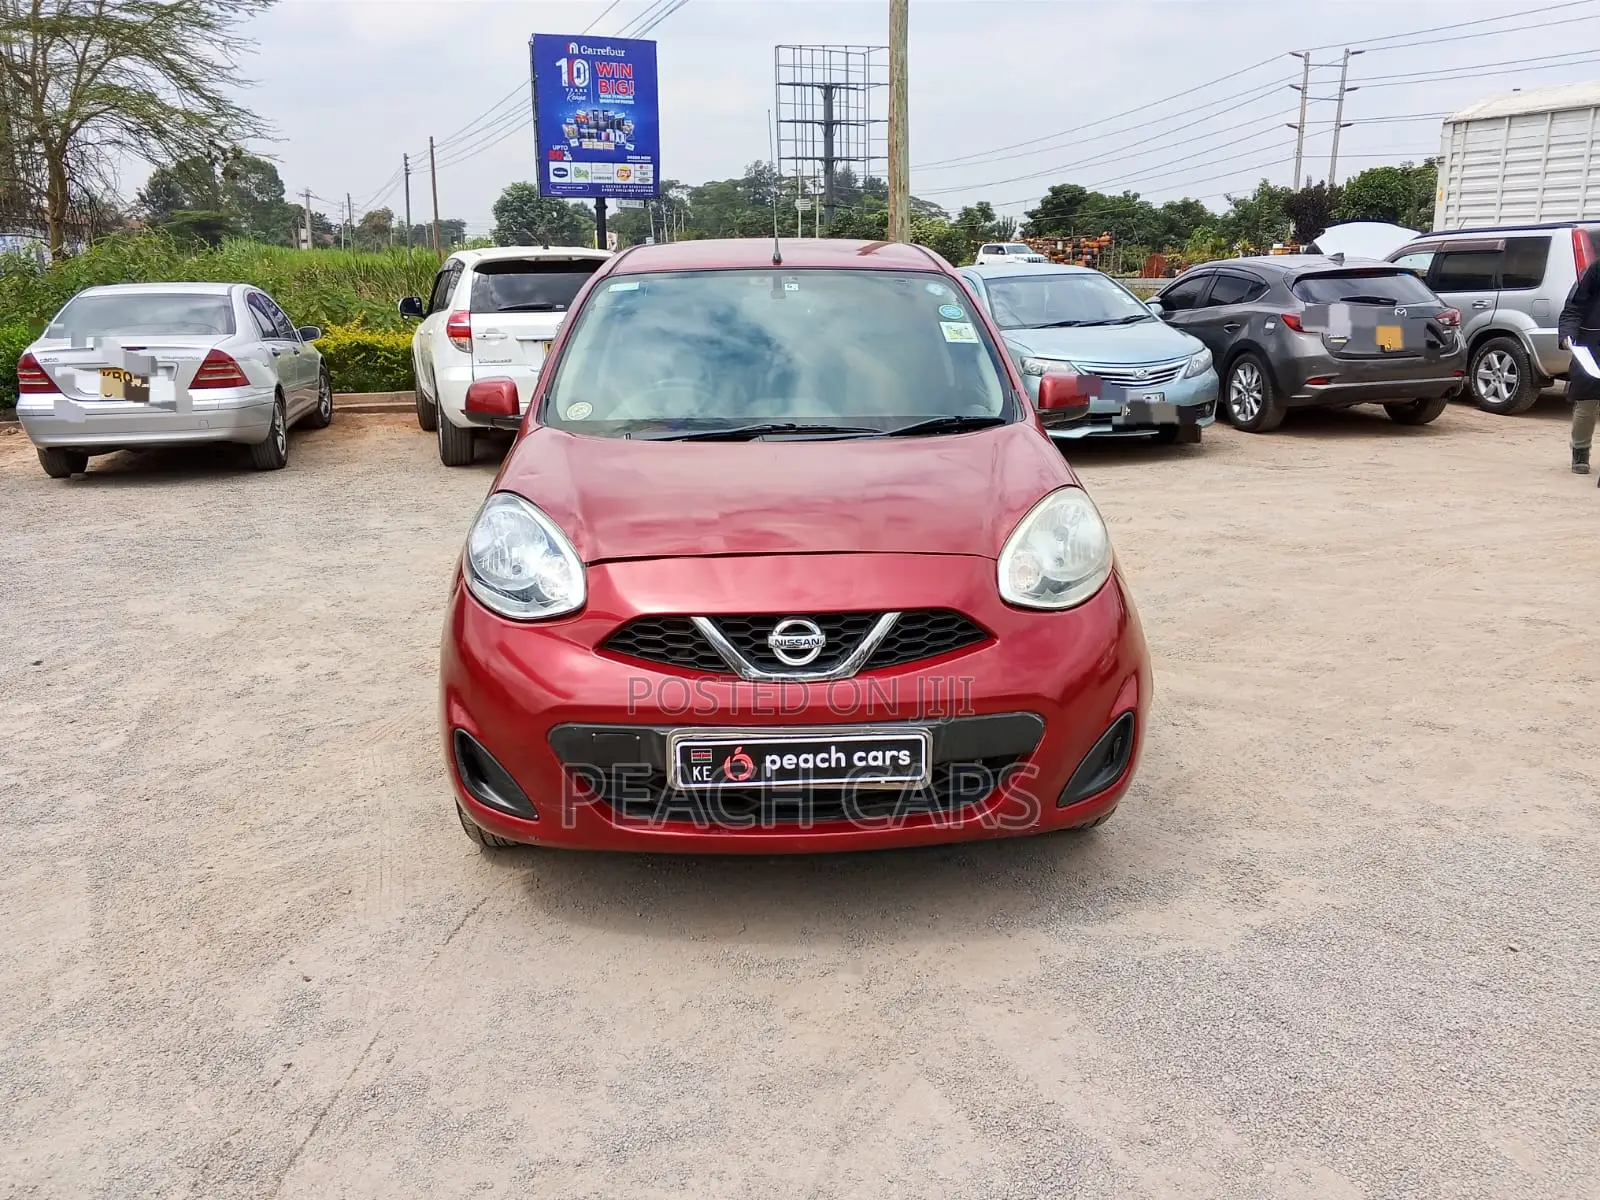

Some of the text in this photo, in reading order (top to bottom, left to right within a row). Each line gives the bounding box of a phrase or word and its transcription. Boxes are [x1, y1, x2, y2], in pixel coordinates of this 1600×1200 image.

[580, 45, 626, 57] Carrefour
[555, 58, 590, 87] 10
[595, 61, 633, 79] WIN
[599, 79, 635, 96] BIG!
[774, 638, 820, 646] NISSAN
[765, 745, 911, 777] peach cars
[692, 765, 712, 781] KE
